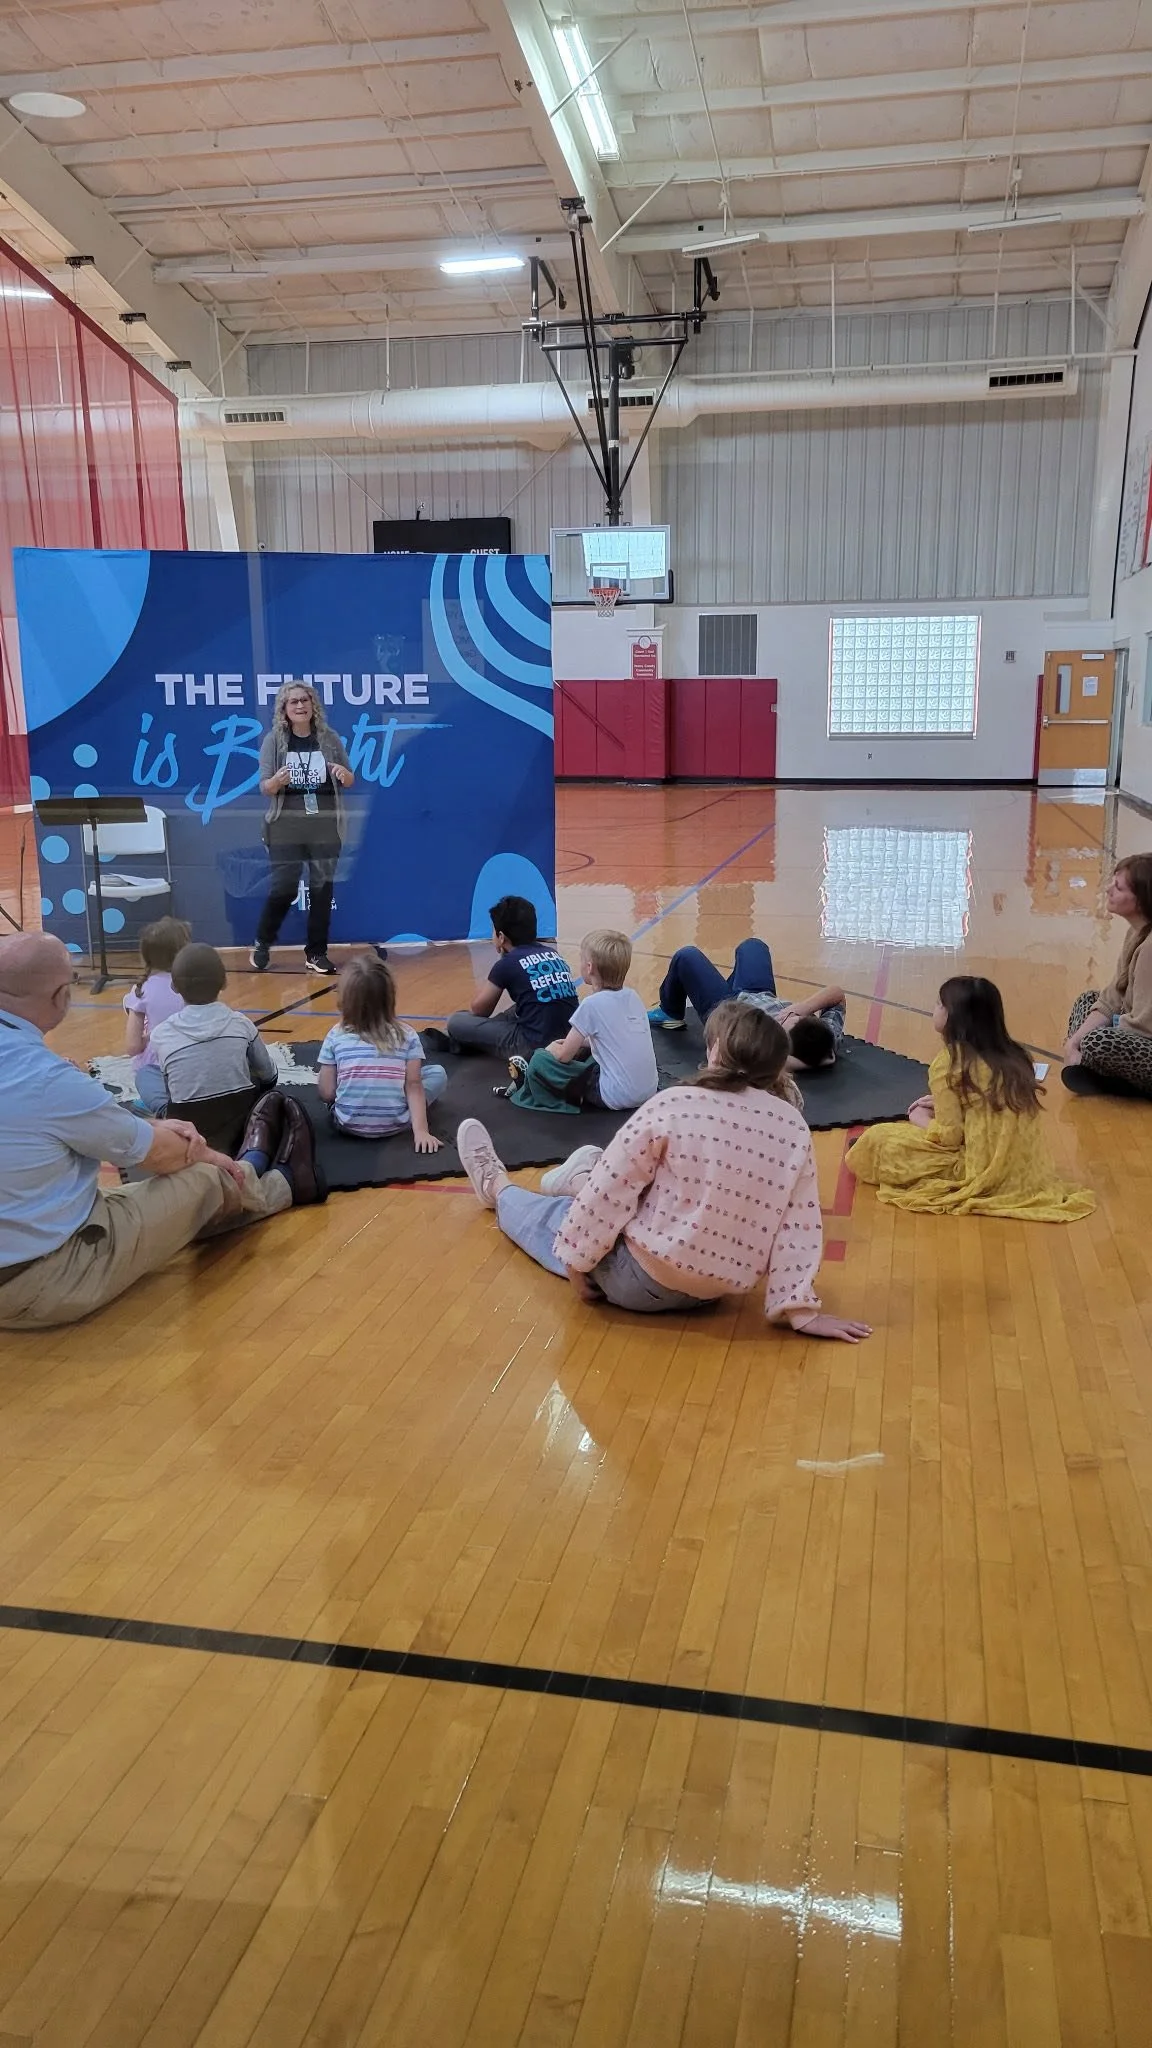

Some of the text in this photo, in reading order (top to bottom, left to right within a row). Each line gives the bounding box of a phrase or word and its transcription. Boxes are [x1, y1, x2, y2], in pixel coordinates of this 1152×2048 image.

[155, 673, 430, 706] THE FTURE
[132, 712, 453, 826] is Bht
